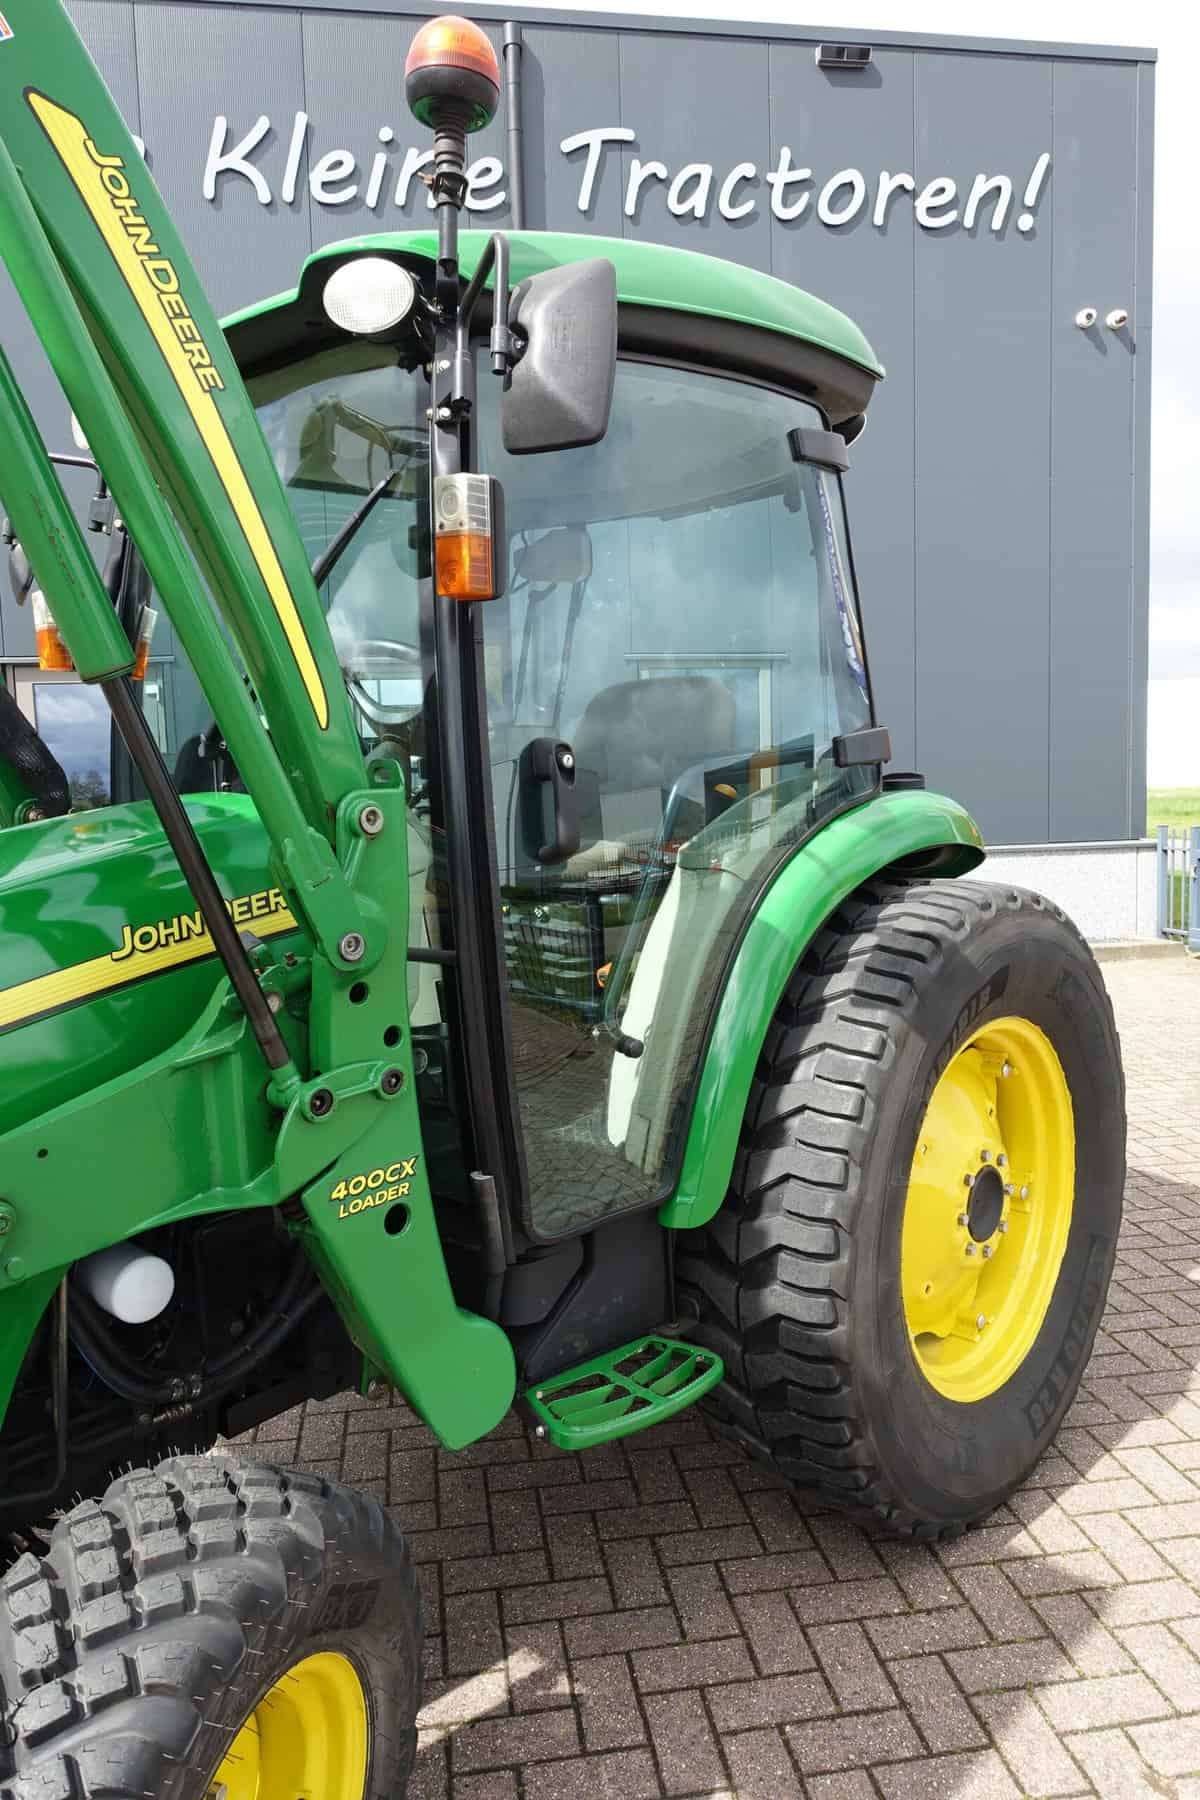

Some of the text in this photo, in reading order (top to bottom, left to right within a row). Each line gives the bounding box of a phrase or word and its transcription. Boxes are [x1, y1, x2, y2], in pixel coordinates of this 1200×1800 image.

[560, 127, 1050, 232] Tractoren!
[84, 138, 225, 393] JOHN DEERE
[111, 910, 205, 961] JOHN
[330, 1156, 418, 1201] 400CX
[338, 1181, 411, 1219] LOADER
